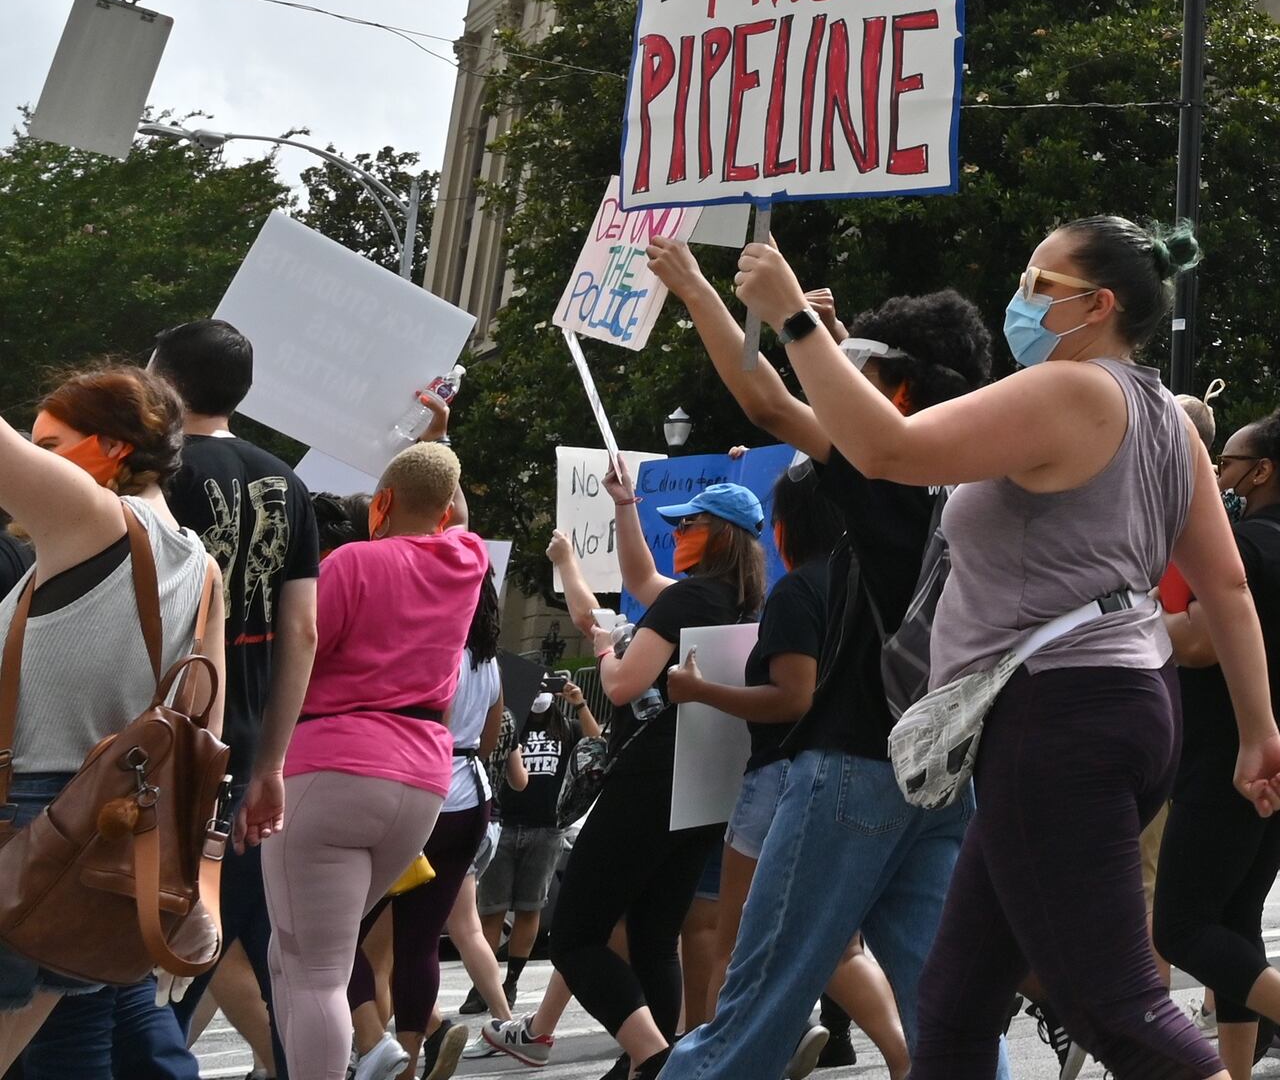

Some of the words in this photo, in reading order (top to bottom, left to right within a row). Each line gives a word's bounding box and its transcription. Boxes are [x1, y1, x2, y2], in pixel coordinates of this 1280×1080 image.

[632, 9, 940, 196] PIPELINE
[602, 245, 646, 291] THE
[524, 755, 559, 774] TTER
